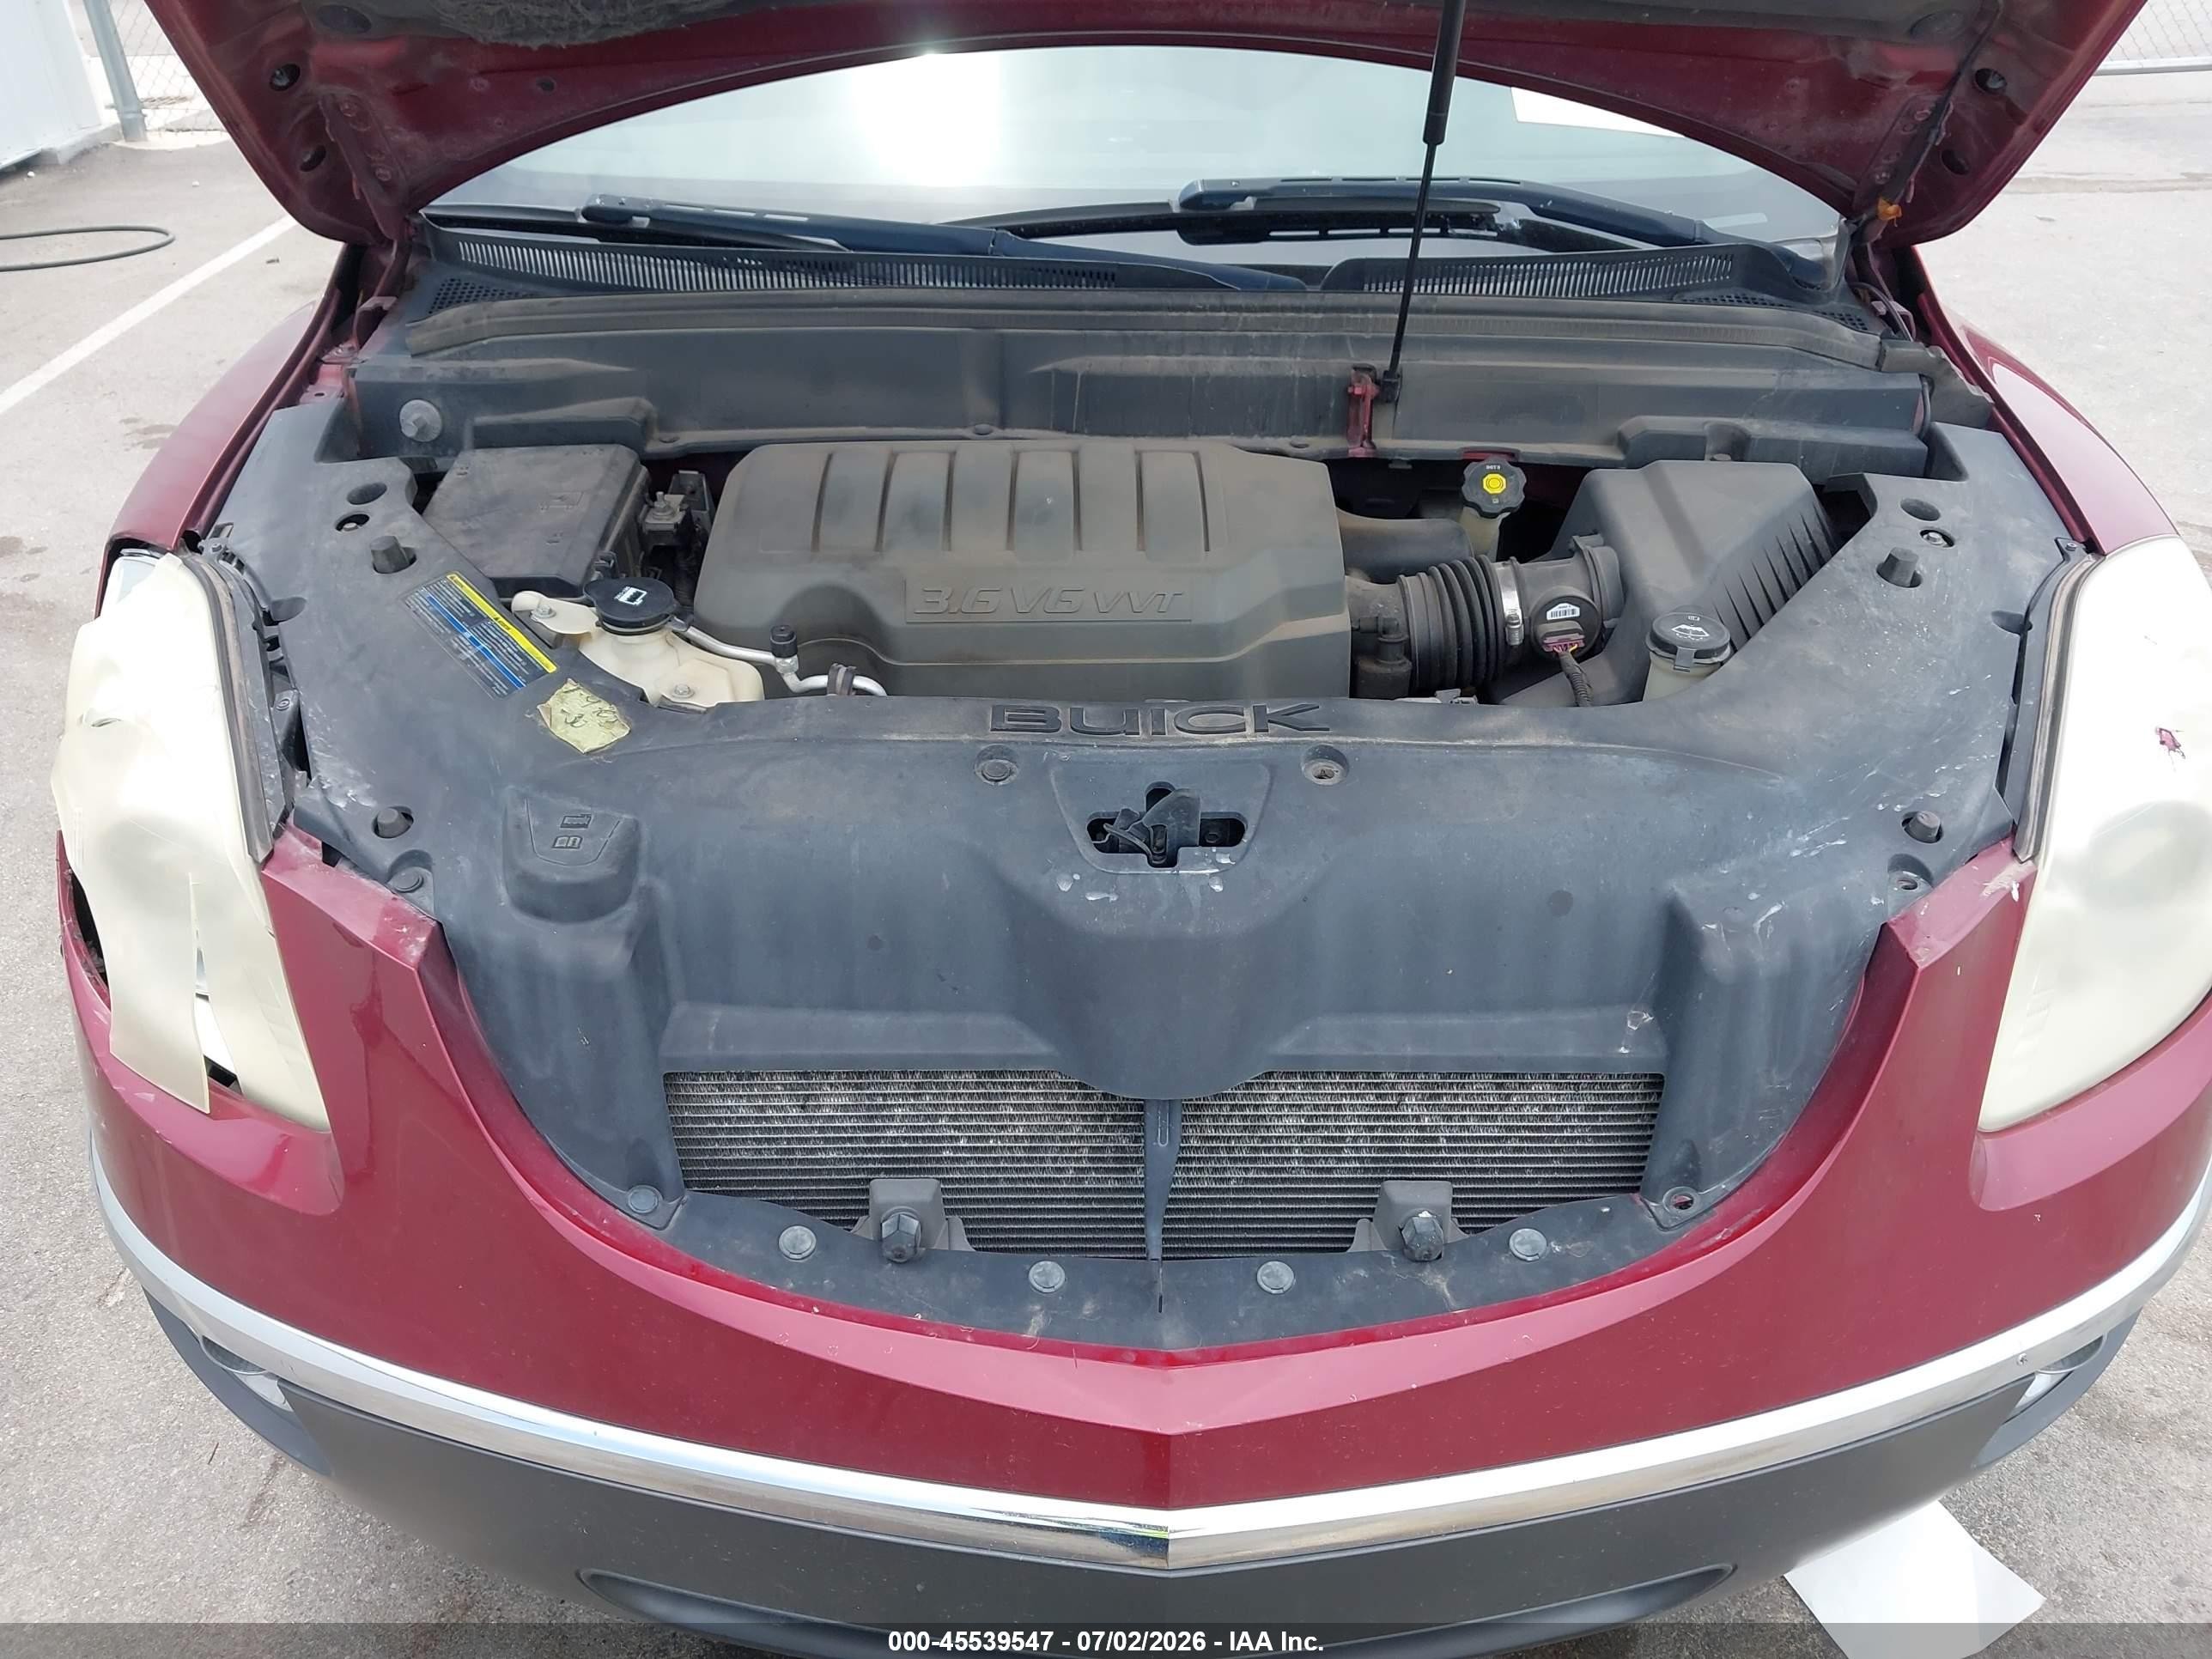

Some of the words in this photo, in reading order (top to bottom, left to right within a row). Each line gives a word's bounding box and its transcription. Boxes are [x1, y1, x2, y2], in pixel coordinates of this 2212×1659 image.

[913, 586, 1002, 615] 3.6
[1011, 586, 1085, 615] V6
[1093, 591, 1184, 614] VVT
[990, 703, 1330, 736] BUICK
